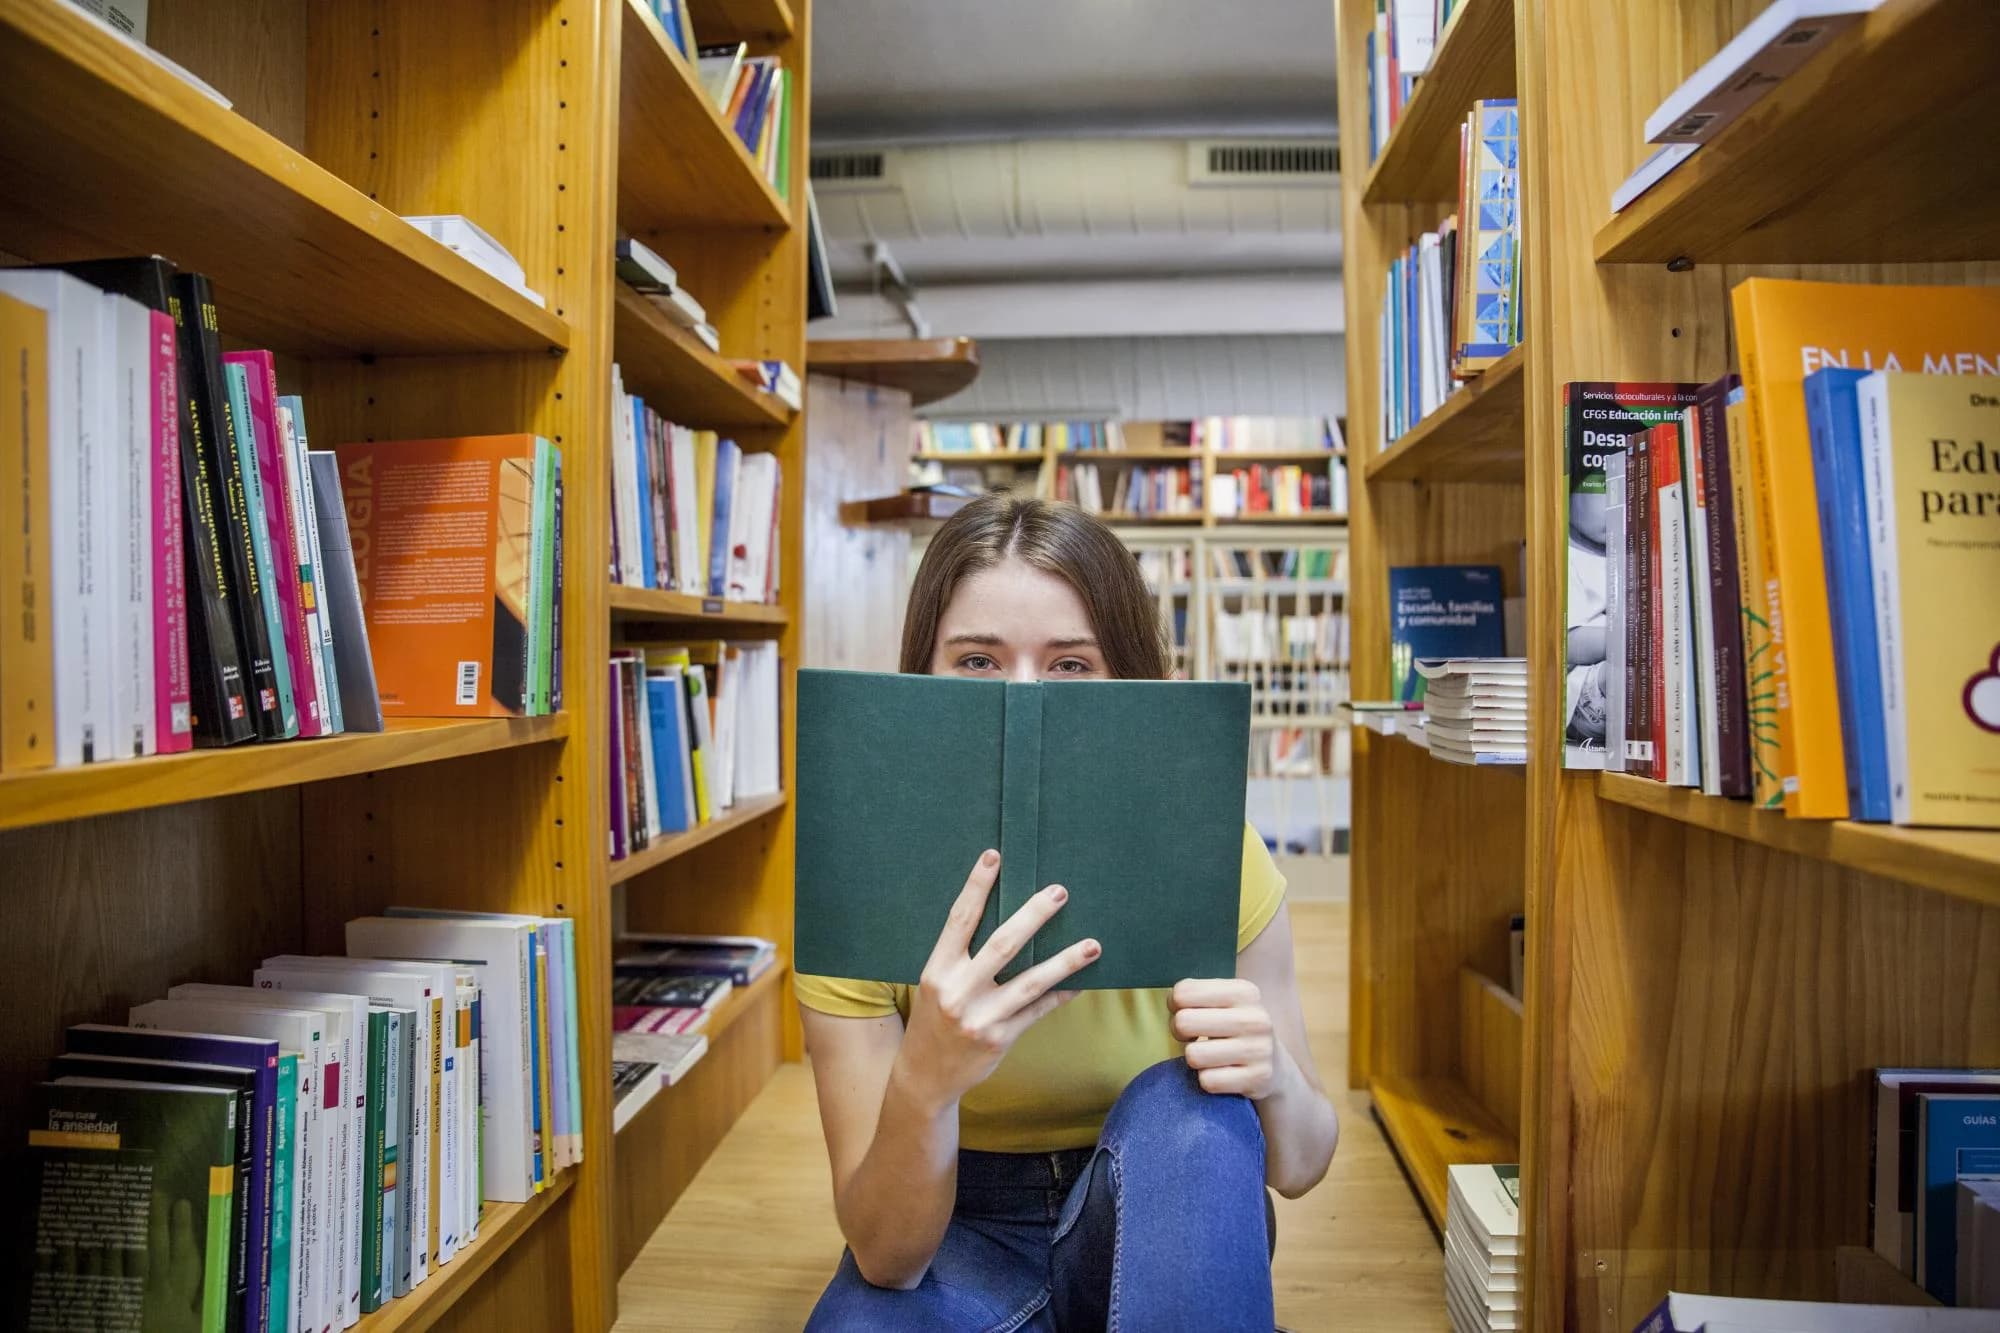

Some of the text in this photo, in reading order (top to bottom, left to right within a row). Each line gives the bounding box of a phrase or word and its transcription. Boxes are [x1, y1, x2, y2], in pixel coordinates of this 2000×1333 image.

[1583, 391, 1613, 400] Servicios
[1614, 392, 1665, 401] socioculturales
[1666, 394, 1670, 402] y
[1677, 393, 1684, 401] la
[1583, 409, 1607, 419] CFGS
[1609, 409, 1660, 420] Educación
[186, 398, 230, 599] MANUAL DE PSICOPATOLOGÍA
[221, 400, 264, 595] MANUAL DE PSICOPATOLOGÍA
[1920, 490, 1999, 524] par
[346, 455, 373, 604] LOGIA
[1639, 529, 1647, 576] educación
[1627, 578, 1633, 590] la
[1628, 592, 1633, 604] de
[1640, 578, 1646, 587] la
[1640, 589, 1646, 601] de
[1639, 677, 1647, 725] Psicología
[331, 1052, 336, 1061] 5
[342, 1037, 350, 1067] bulimia
[432, 1009, 442, 1074] Fobia social
[303, 1077, 309, 1094] 4
[341, 1075, 349, 1109] Anorexia
[49, 1119, 117, 1133] la ansiedad
[376, 1129, 384, 1187] ADOLESCENTES
[352, 1115, 363, 1266] Alteraciones de la imagen corporal
[376, 1220, 381, 1231] EN
[374, 1232, 382, 1276] DEPRESIÓN
